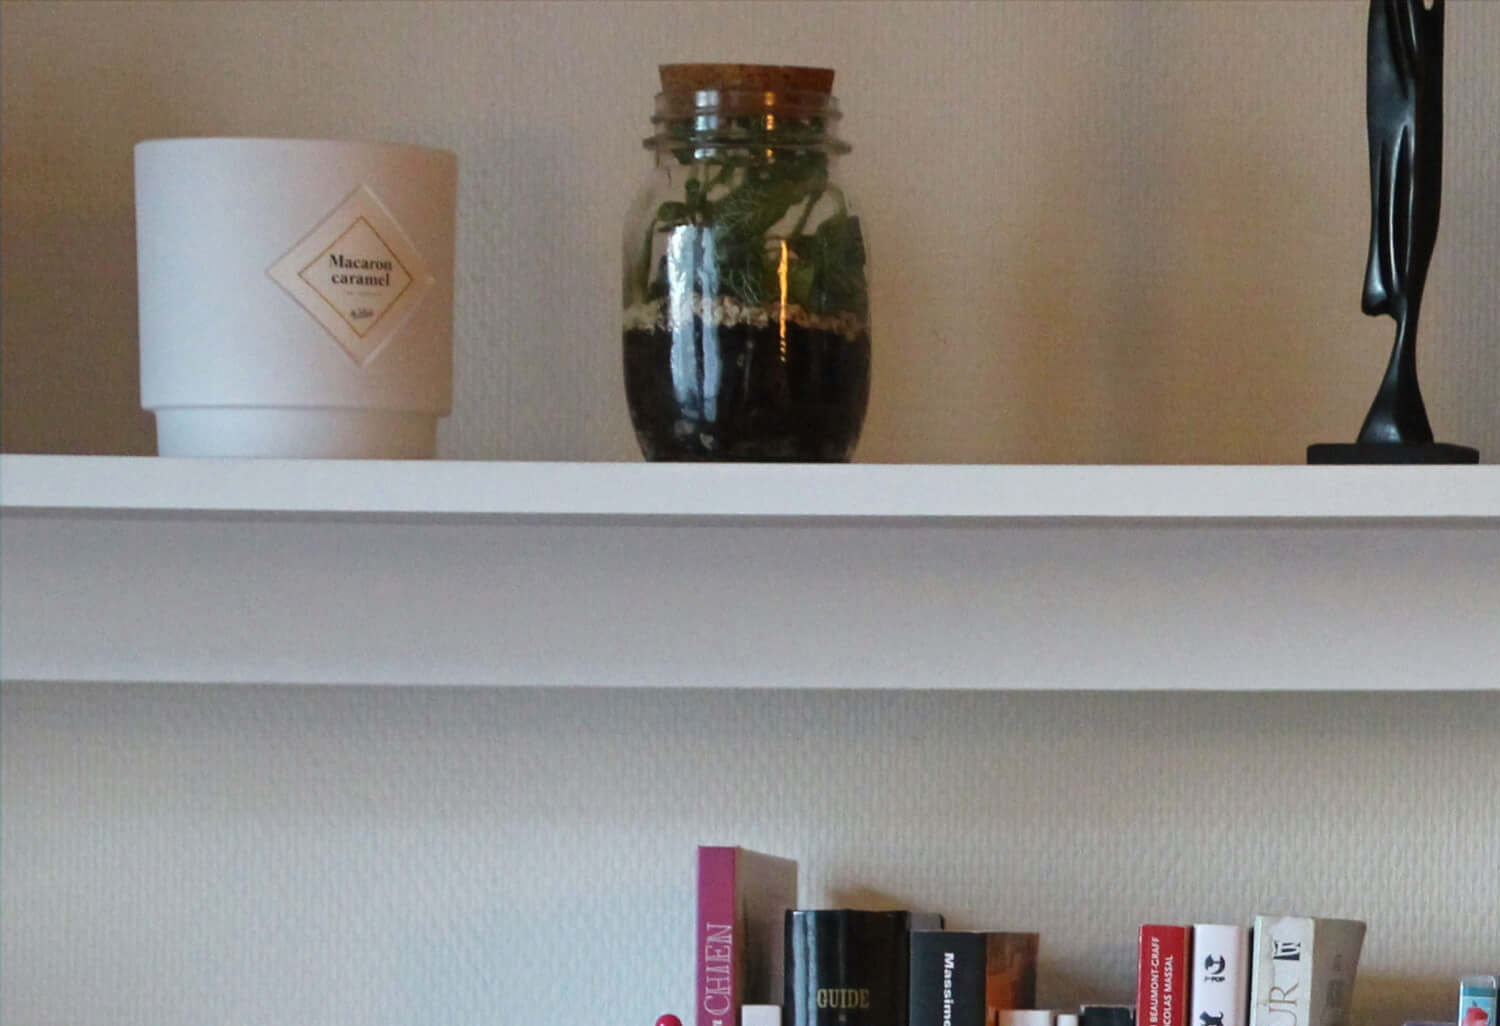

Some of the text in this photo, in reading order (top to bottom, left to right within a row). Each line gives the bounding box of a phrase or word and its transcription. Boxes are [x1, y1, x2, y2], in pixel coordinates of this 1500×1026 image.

[330, 254, 392, 271] Macaron
[331, 273, 390, 287] caramel
[704, 923, 732, 1015] CHIEN
[816, 988, 870, 1008] GUIDE
